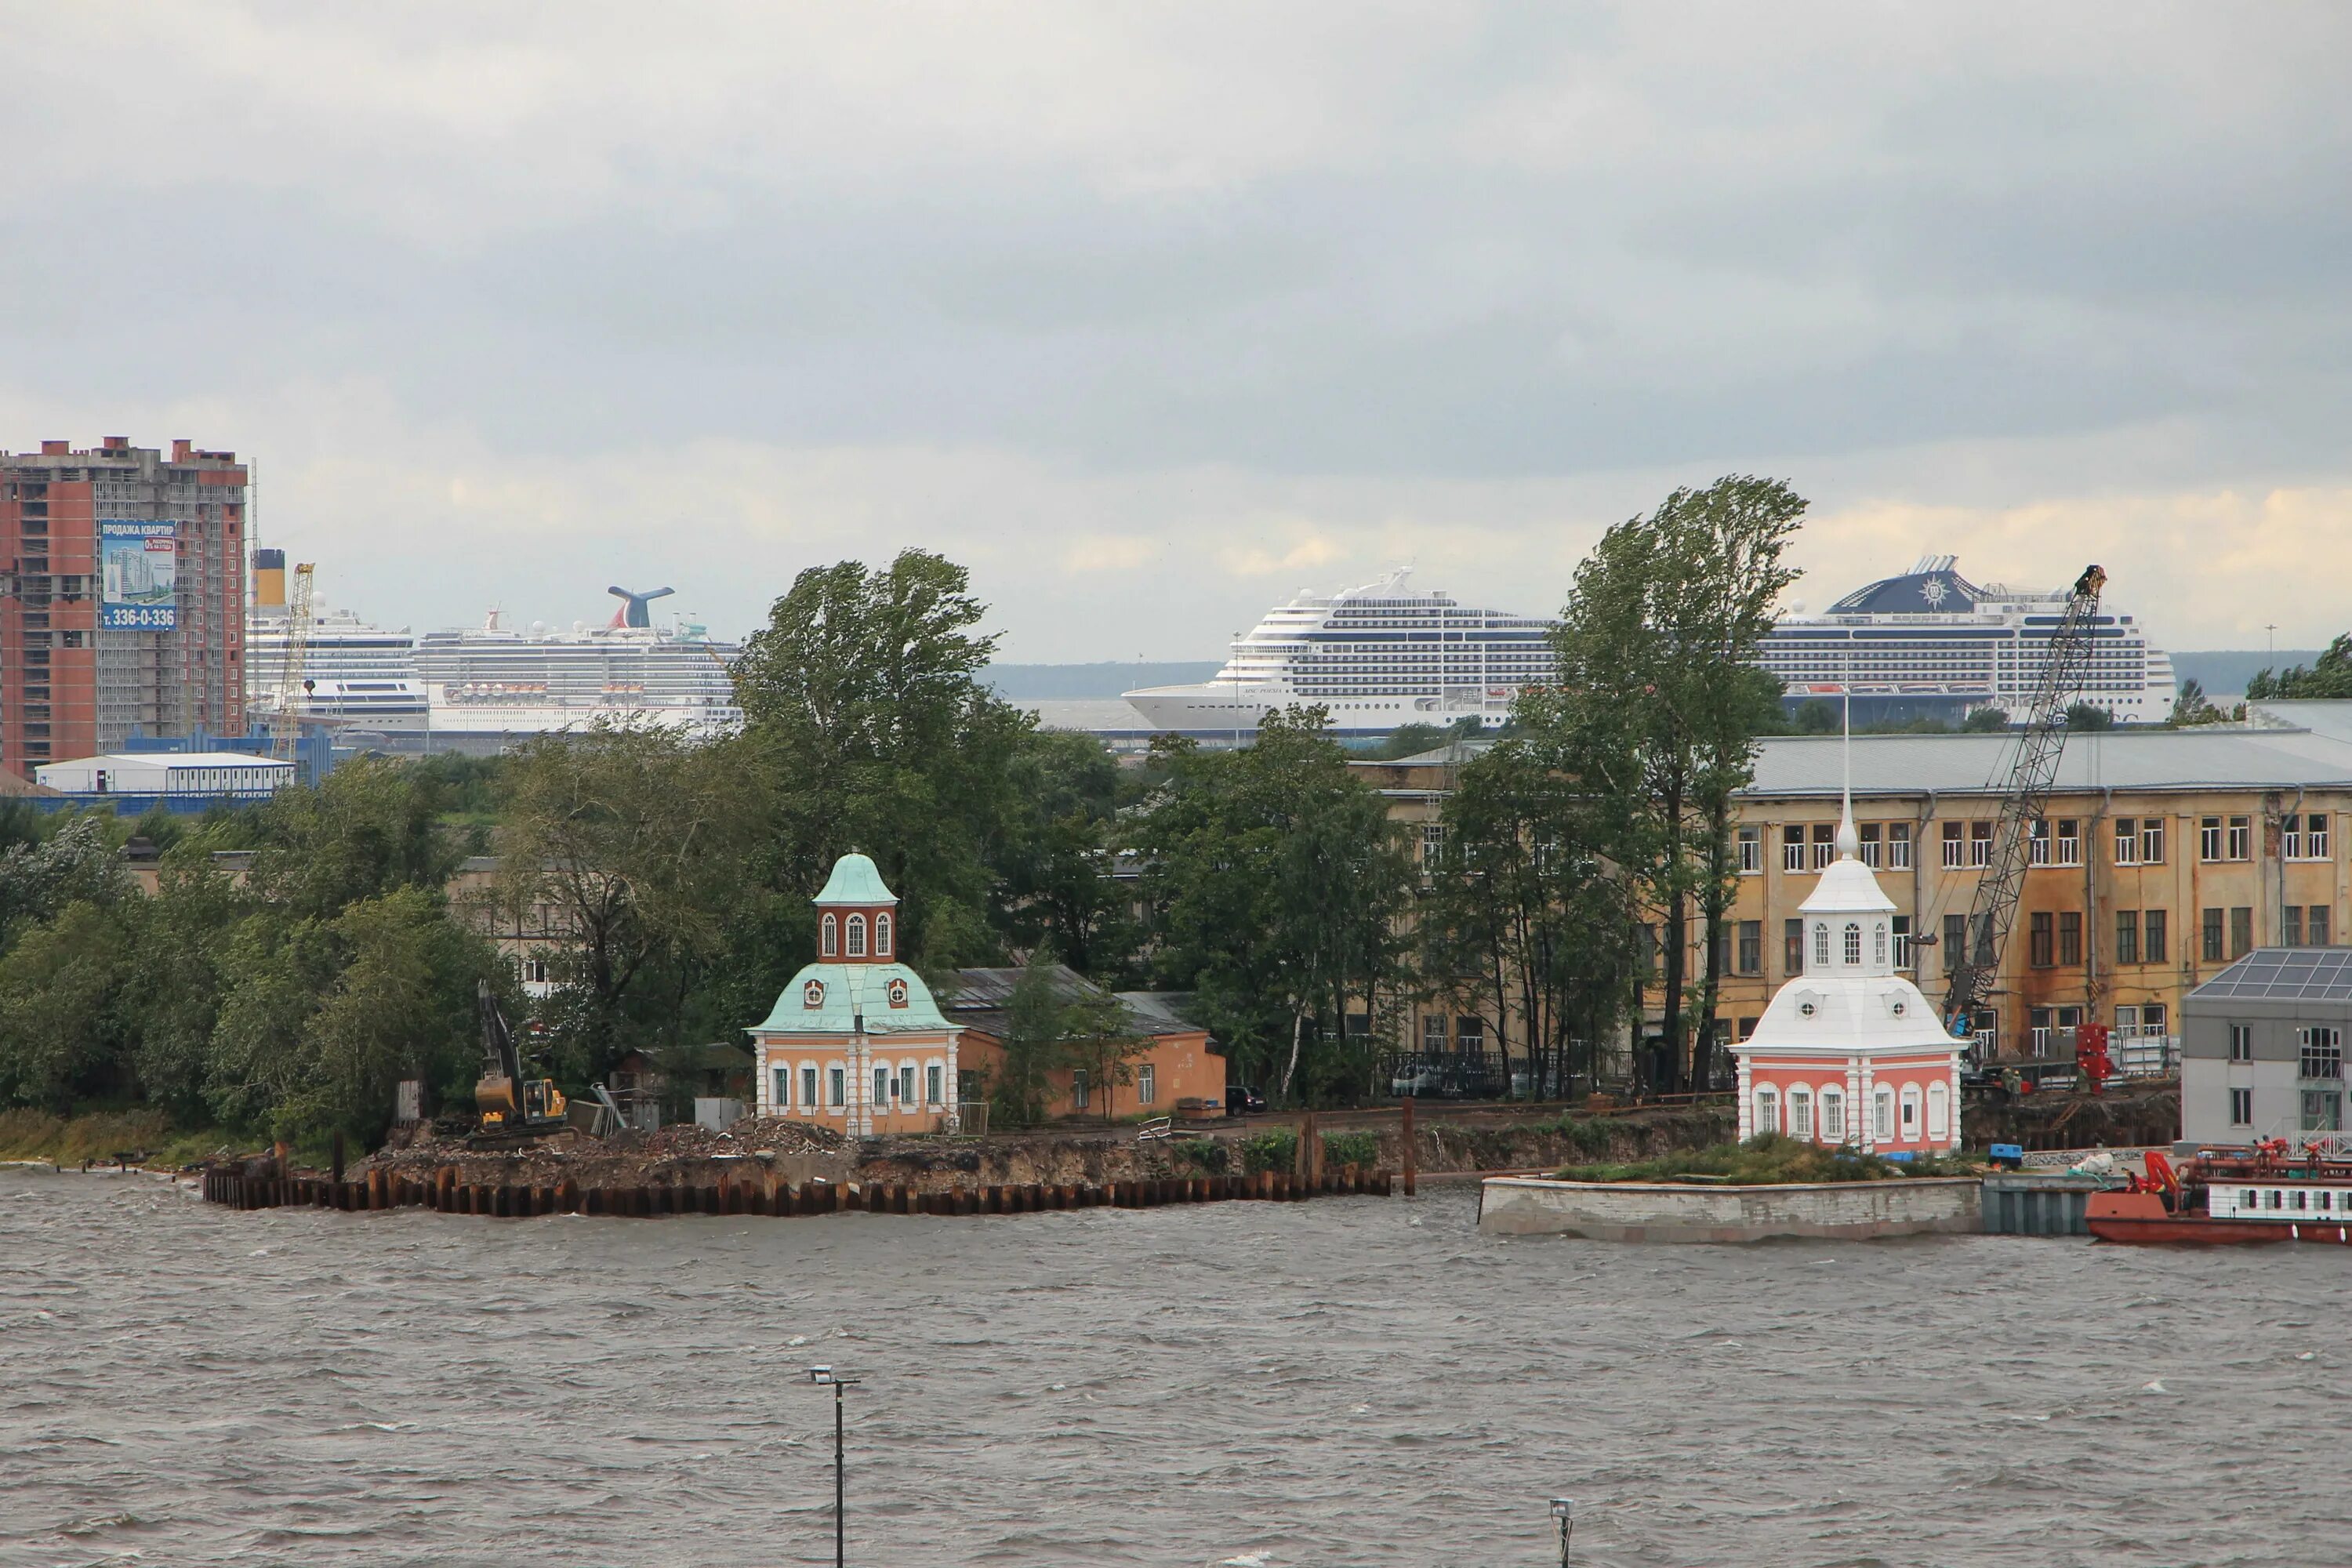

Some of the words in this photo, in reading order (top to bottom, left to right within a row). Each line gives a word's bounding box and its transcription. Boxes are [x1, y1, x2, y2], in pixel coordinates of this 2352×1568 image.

[103, 524, 140, 536] ПРОДАЖА
[141, 525, 174, 535] КВАРТИР
[103, 615, 111, 625] т.
[113, 609, 174, 626] 336-0-336
